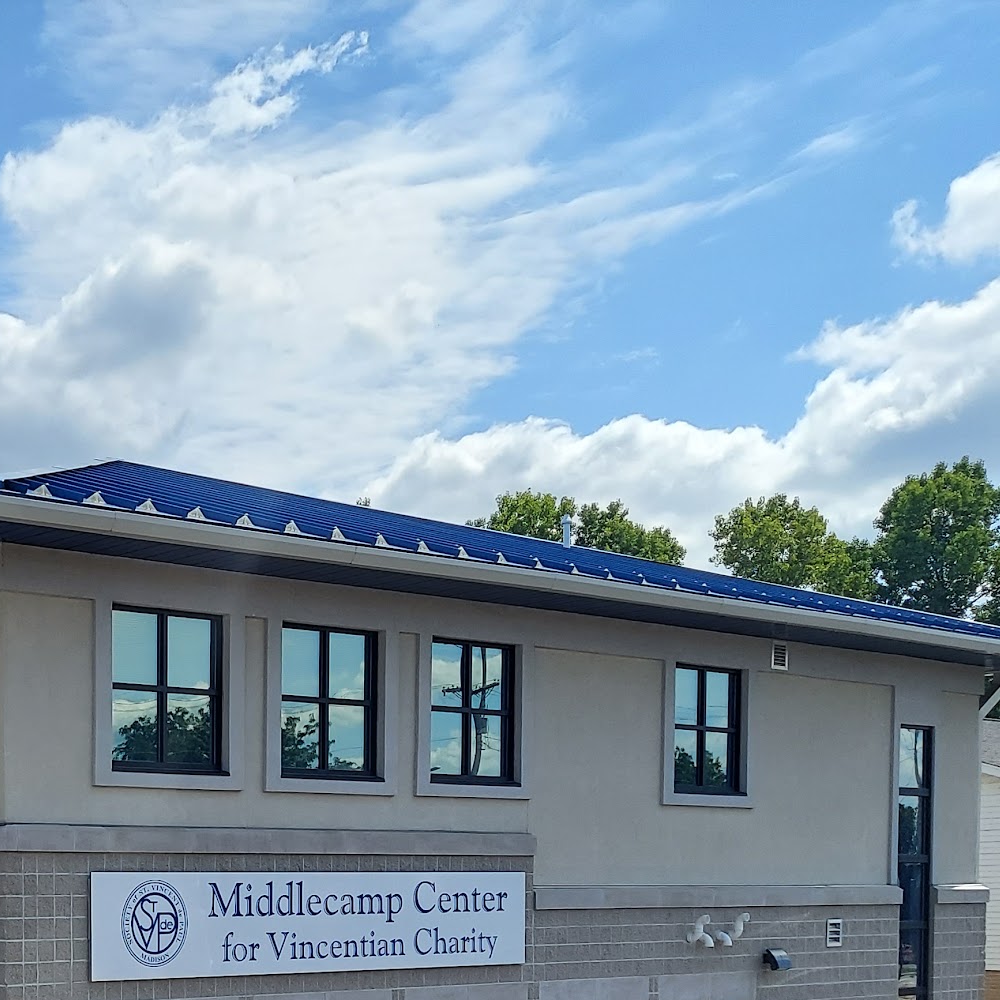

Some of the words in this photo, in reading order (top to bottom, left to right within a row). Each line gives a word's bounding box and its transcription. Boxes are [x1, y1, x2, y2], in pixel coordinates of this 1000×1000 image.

[208, 881, 403, 922] Middlecamp
[413, 880, 508, 914] Center
[140, 953, 170, 963] MADISON
[221, 932, 261, 963] for
[266, 930, 406, 961] Vincentian
[414, 927, 498, 960] Charity
